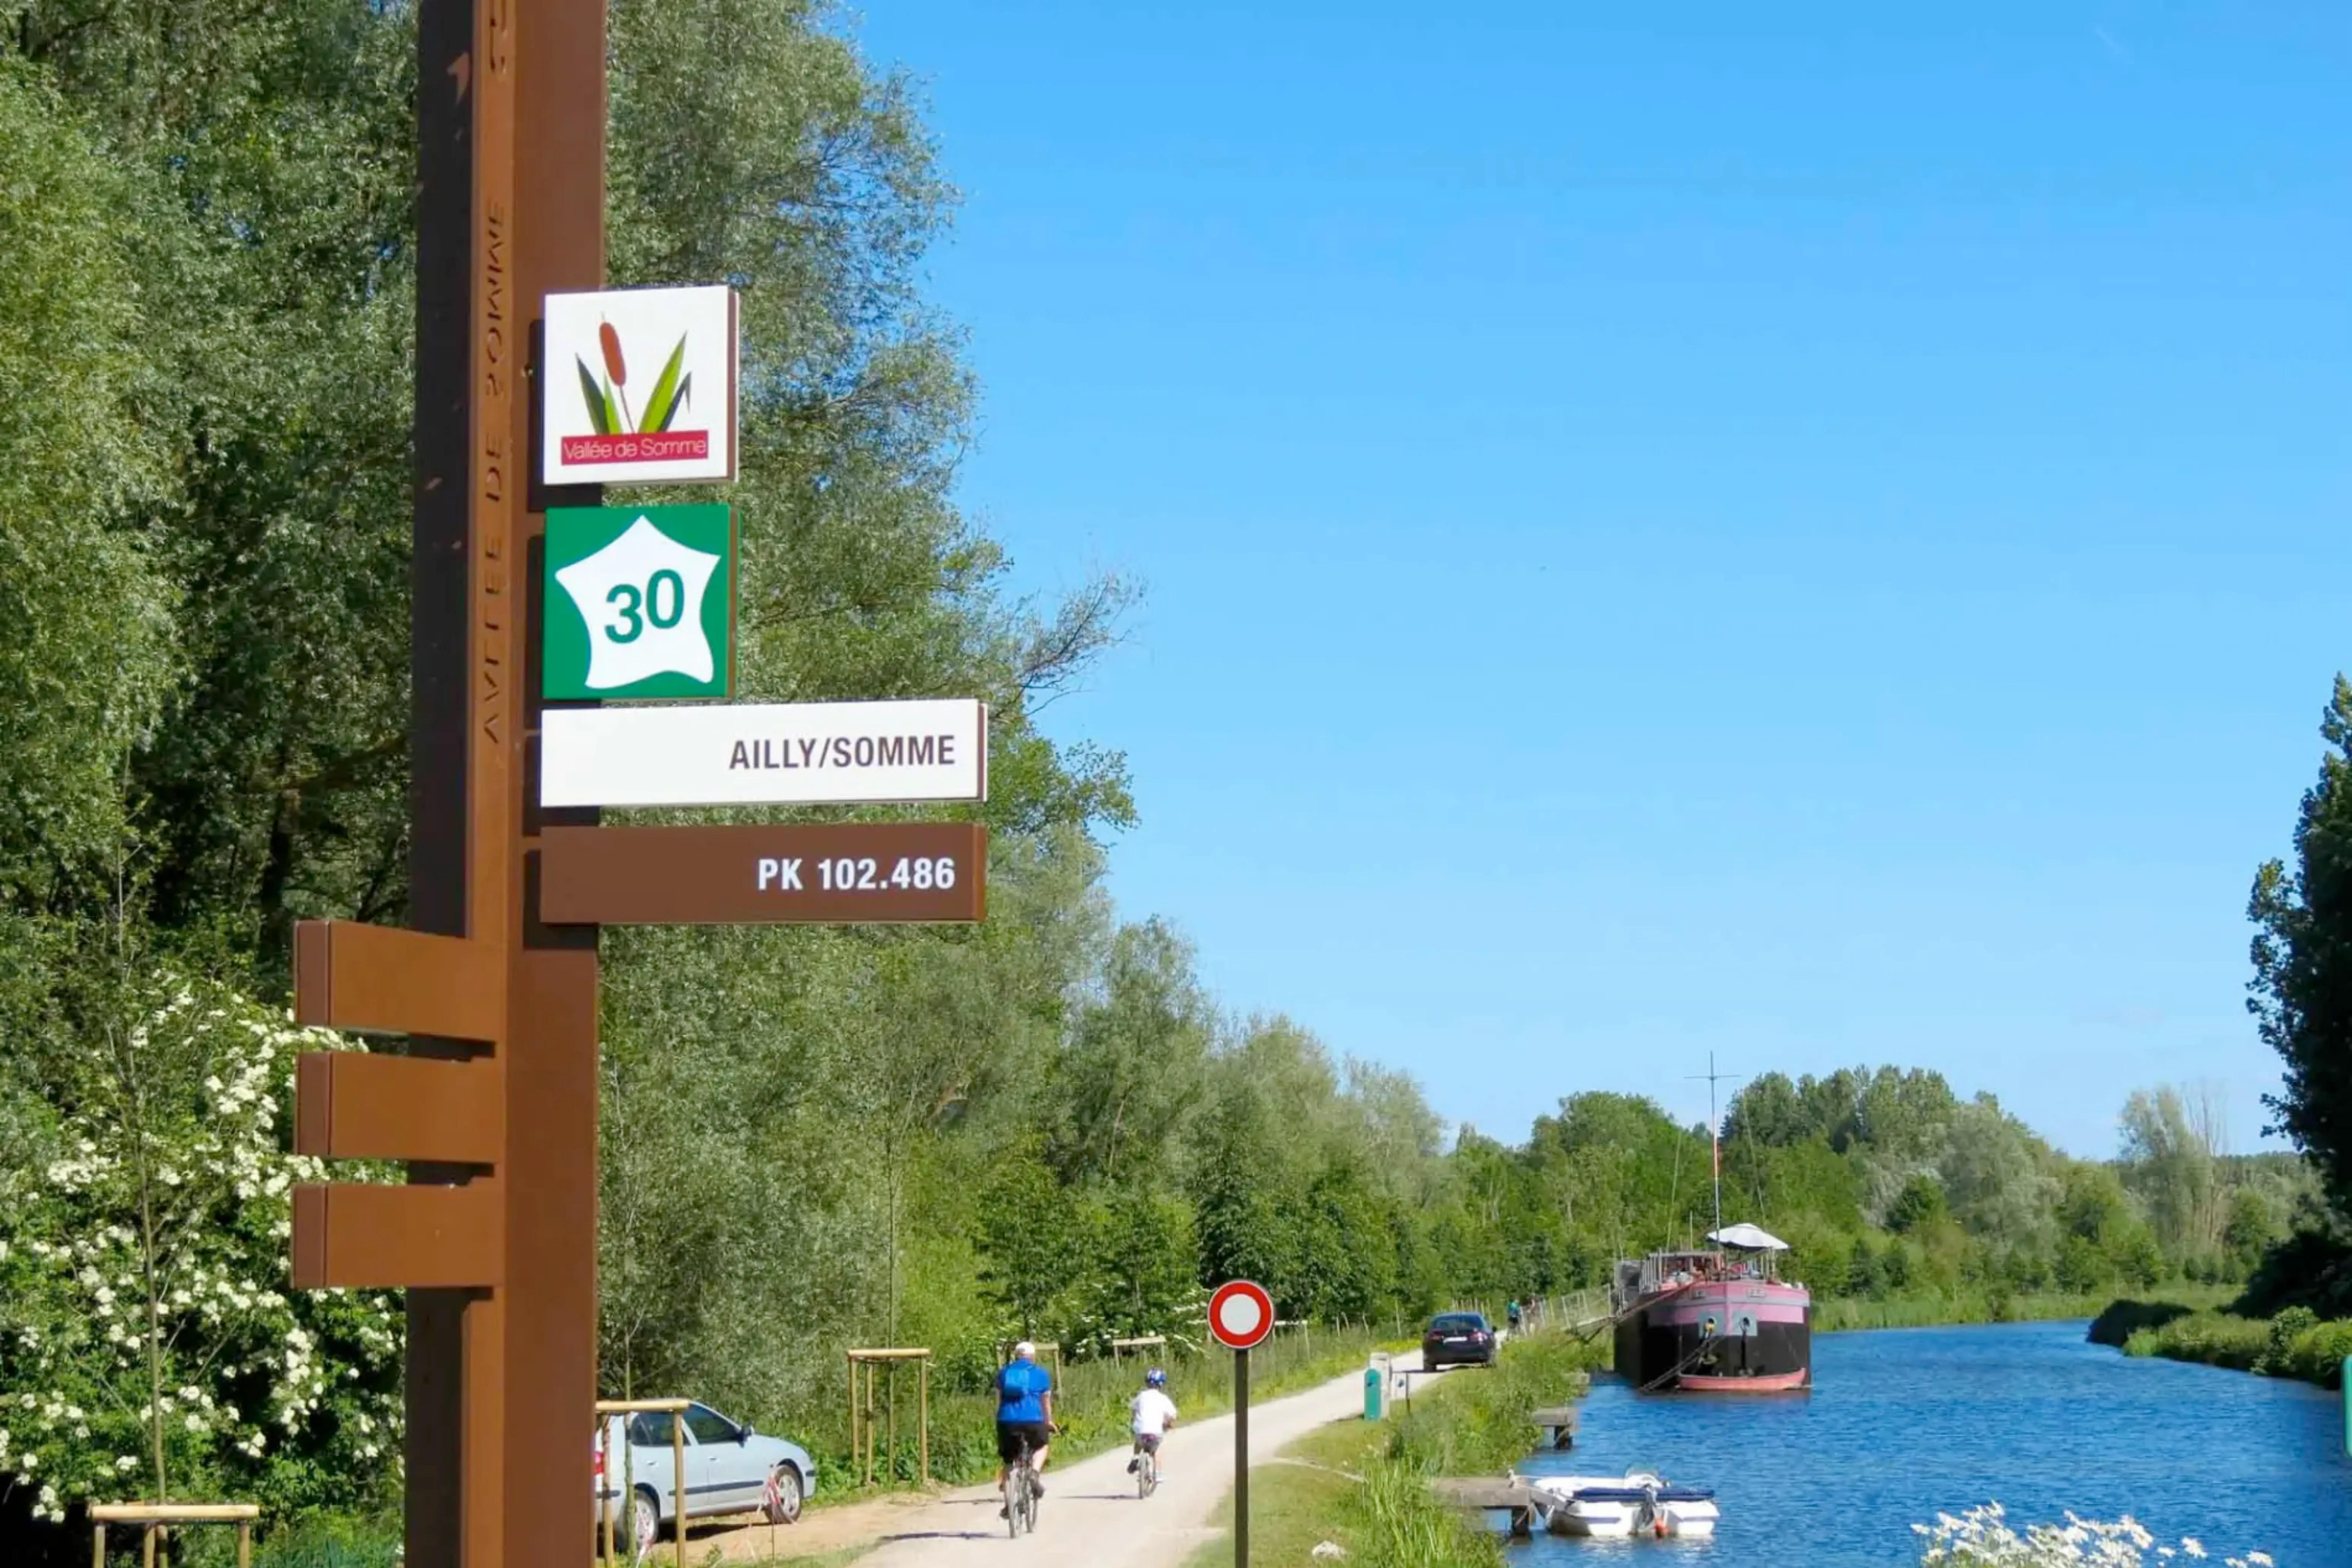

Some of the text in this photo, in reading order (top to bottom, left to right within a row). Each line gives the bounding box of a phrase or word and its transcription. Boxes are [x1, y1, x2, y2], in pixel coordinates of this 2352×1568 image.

[564, 438, 706, 460] Vallée de Somme
[604, 568, 685, 645] 30
[729, 734, 956, 770] AILLY/SOMME
[758, 857, 956, 891] PK 102.486
